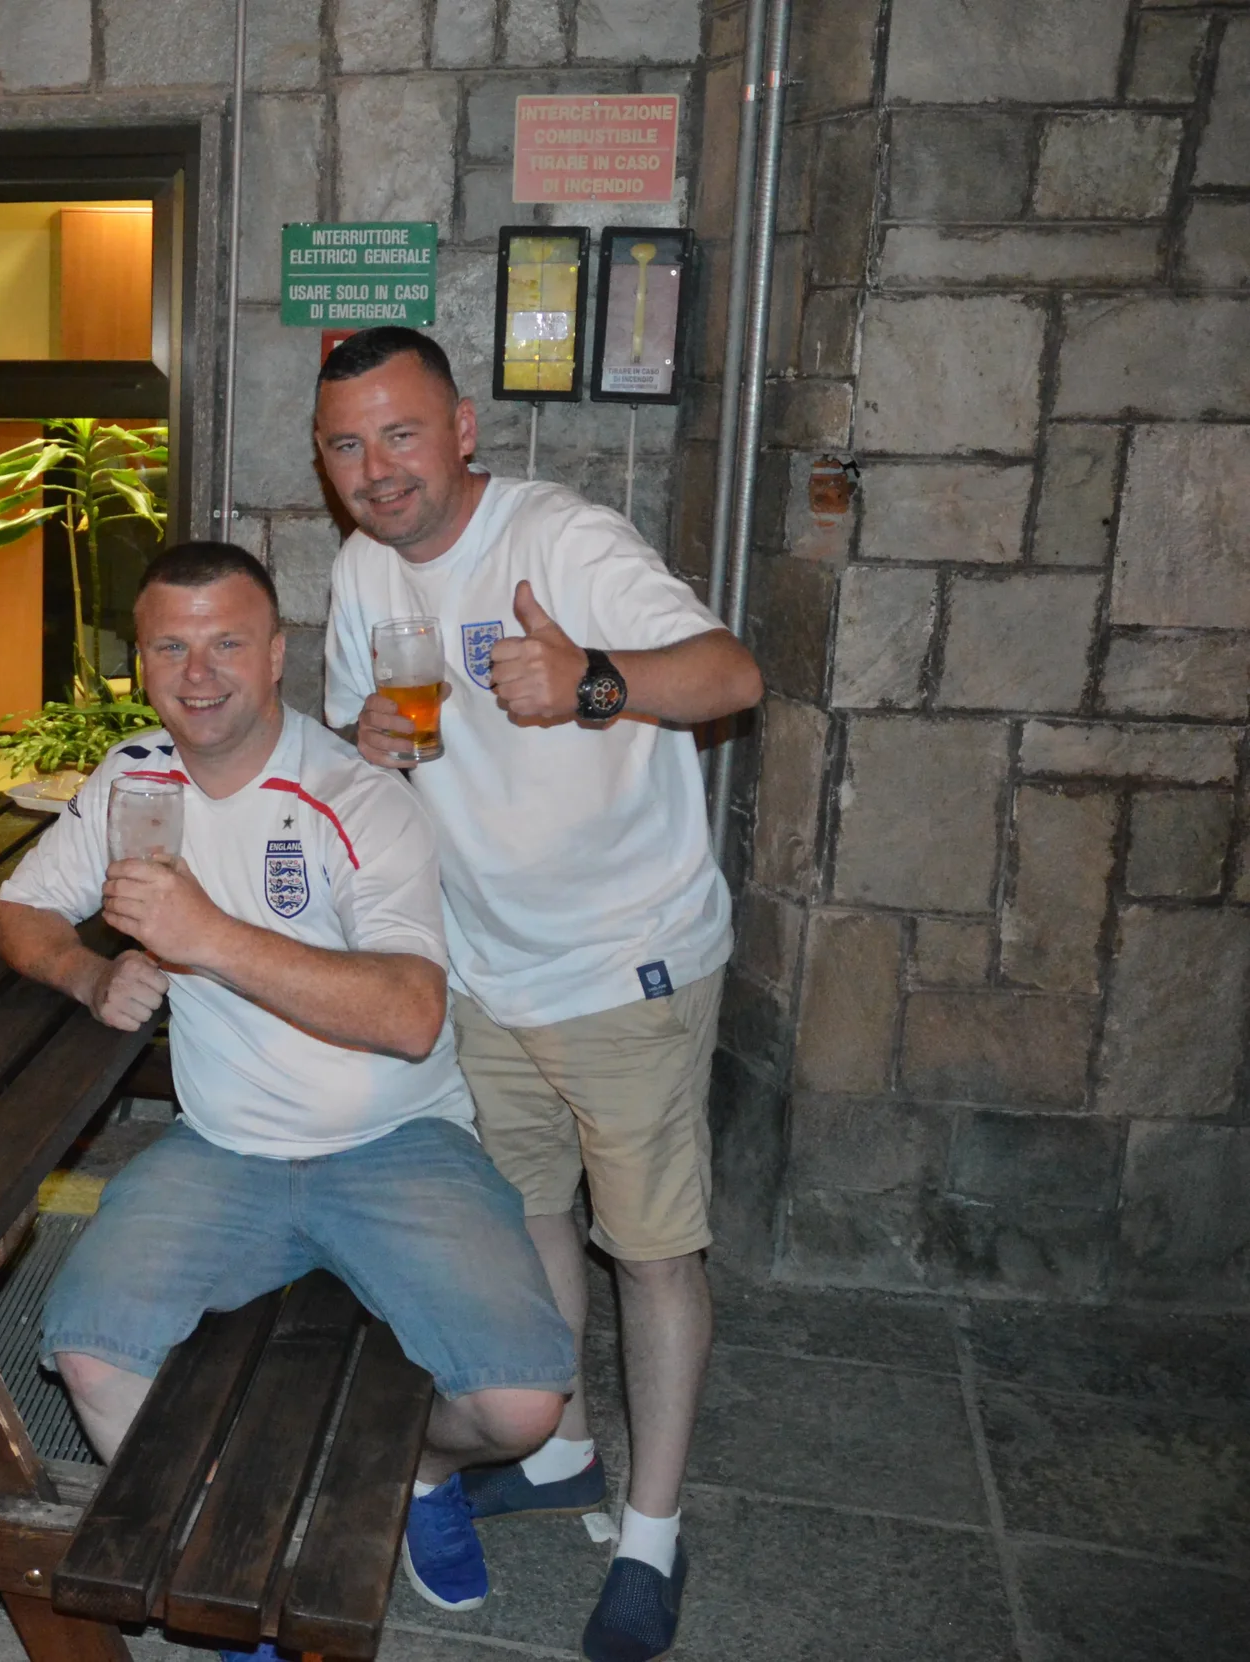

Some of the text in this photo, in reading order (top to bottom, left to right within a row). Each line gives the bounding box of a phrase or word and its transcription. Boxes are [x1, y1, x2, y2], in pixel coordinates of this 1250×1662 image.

[521, 105, 674, 121] INTERCETTAZIONE
[534, 128, 658, 144] COMBUSTIBILE
[530, 155, 661, 171] TIRARE IN CASO
[543, 178, 644, 193] DI INCENDIO
[312, 229, 409, 245] INTERRUTTORE
[289, 248, 431, 265] ELETTRICO GENERALE
[289, 284, 429, 300] USARE SOLO IN CASO
[310, 303, 407, 319] DI EMERGENZA
[608, 367, 660, 375] TIRARE IN CASO
[270, 843, 302, 851] ENGLAND
